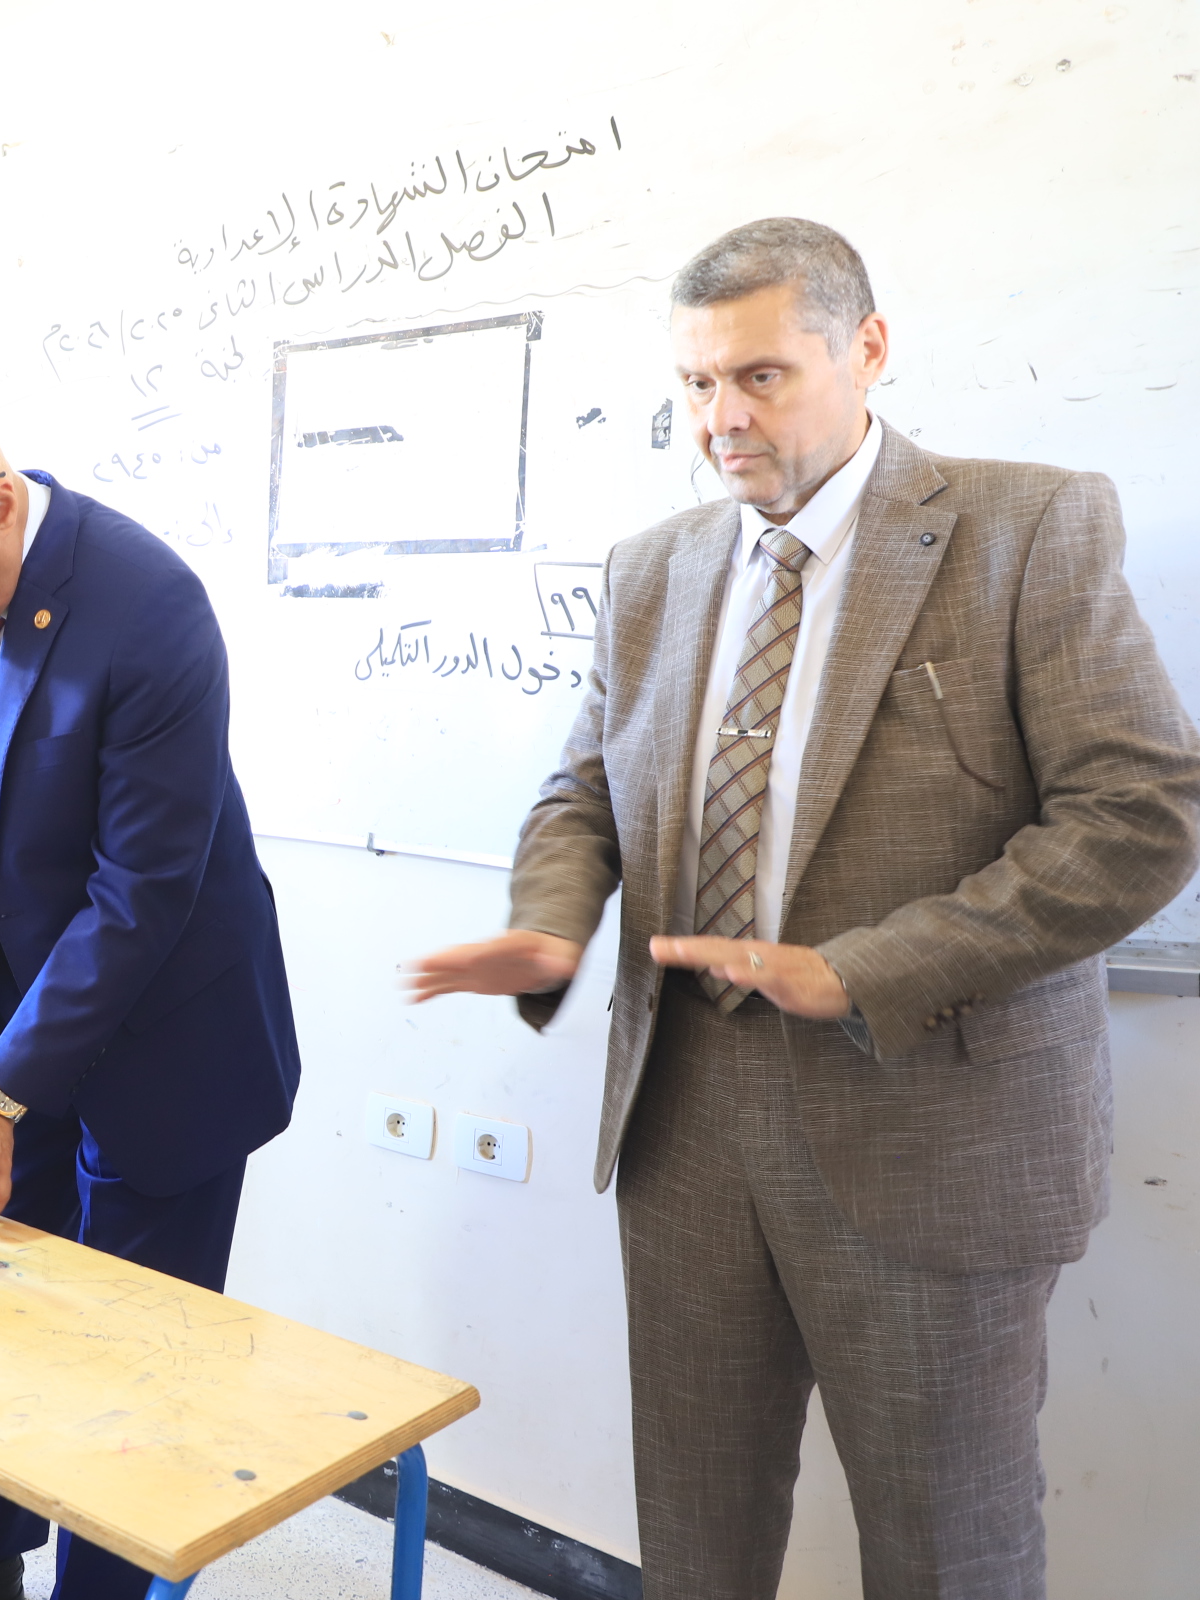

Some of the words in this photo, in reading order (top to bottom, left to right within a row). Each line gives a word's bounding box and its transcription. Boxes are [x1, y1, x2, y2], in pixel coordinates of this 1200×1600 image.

[326, 149, 468, 236] الشهادة
[475, 115, 622, 193] امتحان
[417, 191, 556, 282] الفصل
[130, 363, 164, 398] ١٢
[431, 631, 494, 679] الدور
